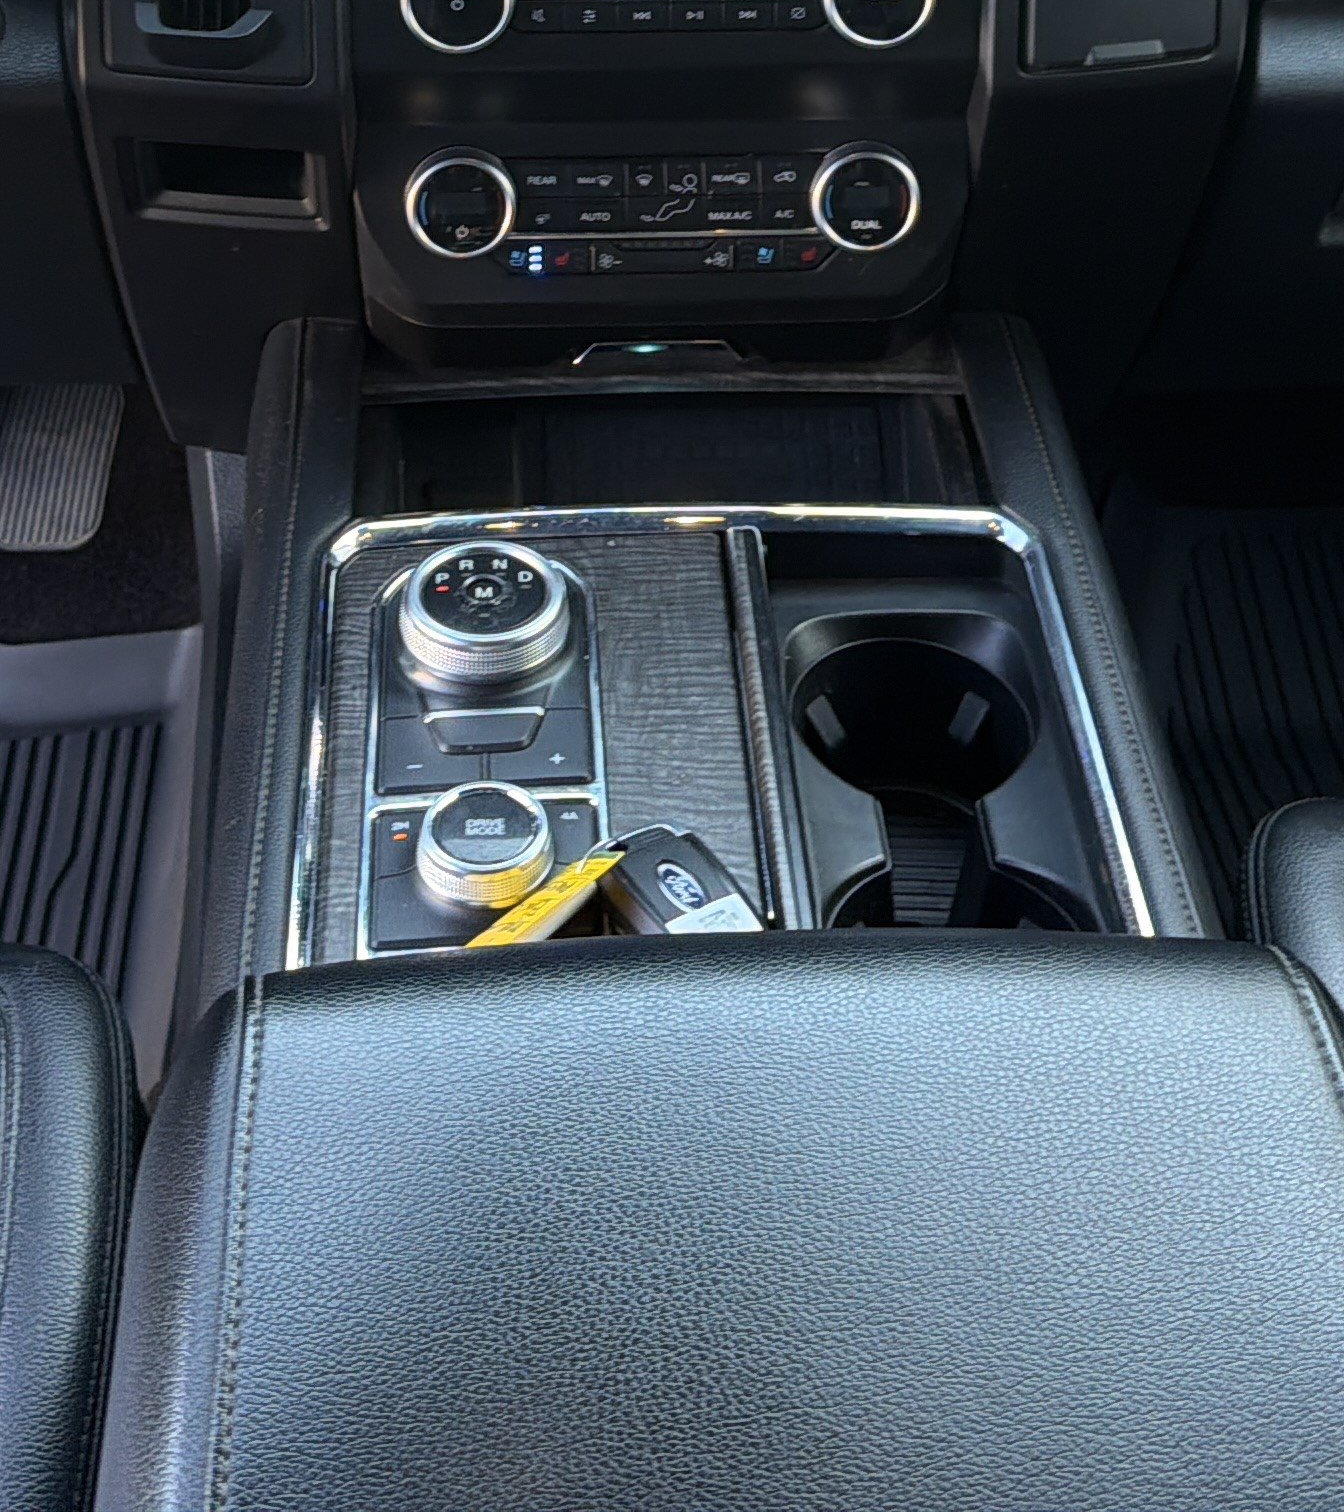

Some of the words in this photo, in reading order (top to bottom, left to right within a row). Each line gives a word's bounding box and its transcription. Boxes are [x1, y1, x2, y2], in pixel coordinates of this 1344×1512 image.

[579, 212, 611, 222] AUTO
[850, 220, 882, 230] DUAL
[458, 559, 474, 570] R
[492, 559, 508, 570] N
[435, 572, 450, 584] P
[517, 571, 533, 582] D
[474, 586, 493, 598] M
